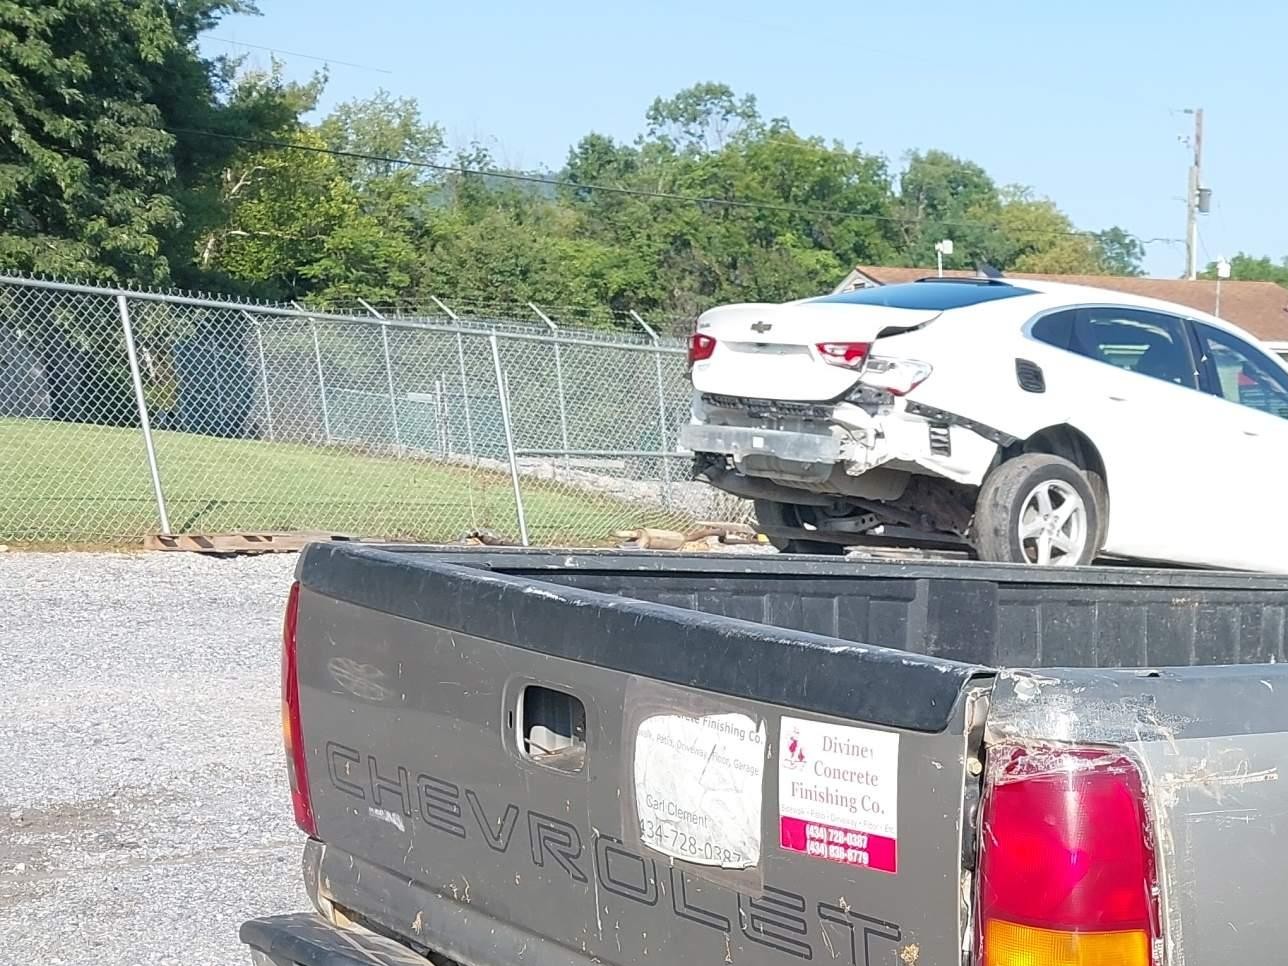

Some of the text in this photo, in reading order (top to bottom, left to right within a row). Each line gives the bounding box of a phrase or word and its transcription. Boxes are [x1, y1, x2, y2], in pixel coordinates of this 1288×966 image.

[702, 717, 746, 741] Finishing
[748, 730, 764, 745] Co.
[813, 760, 880, 788] Concrete
[790, 780, 886, 816] Finishing Co.
